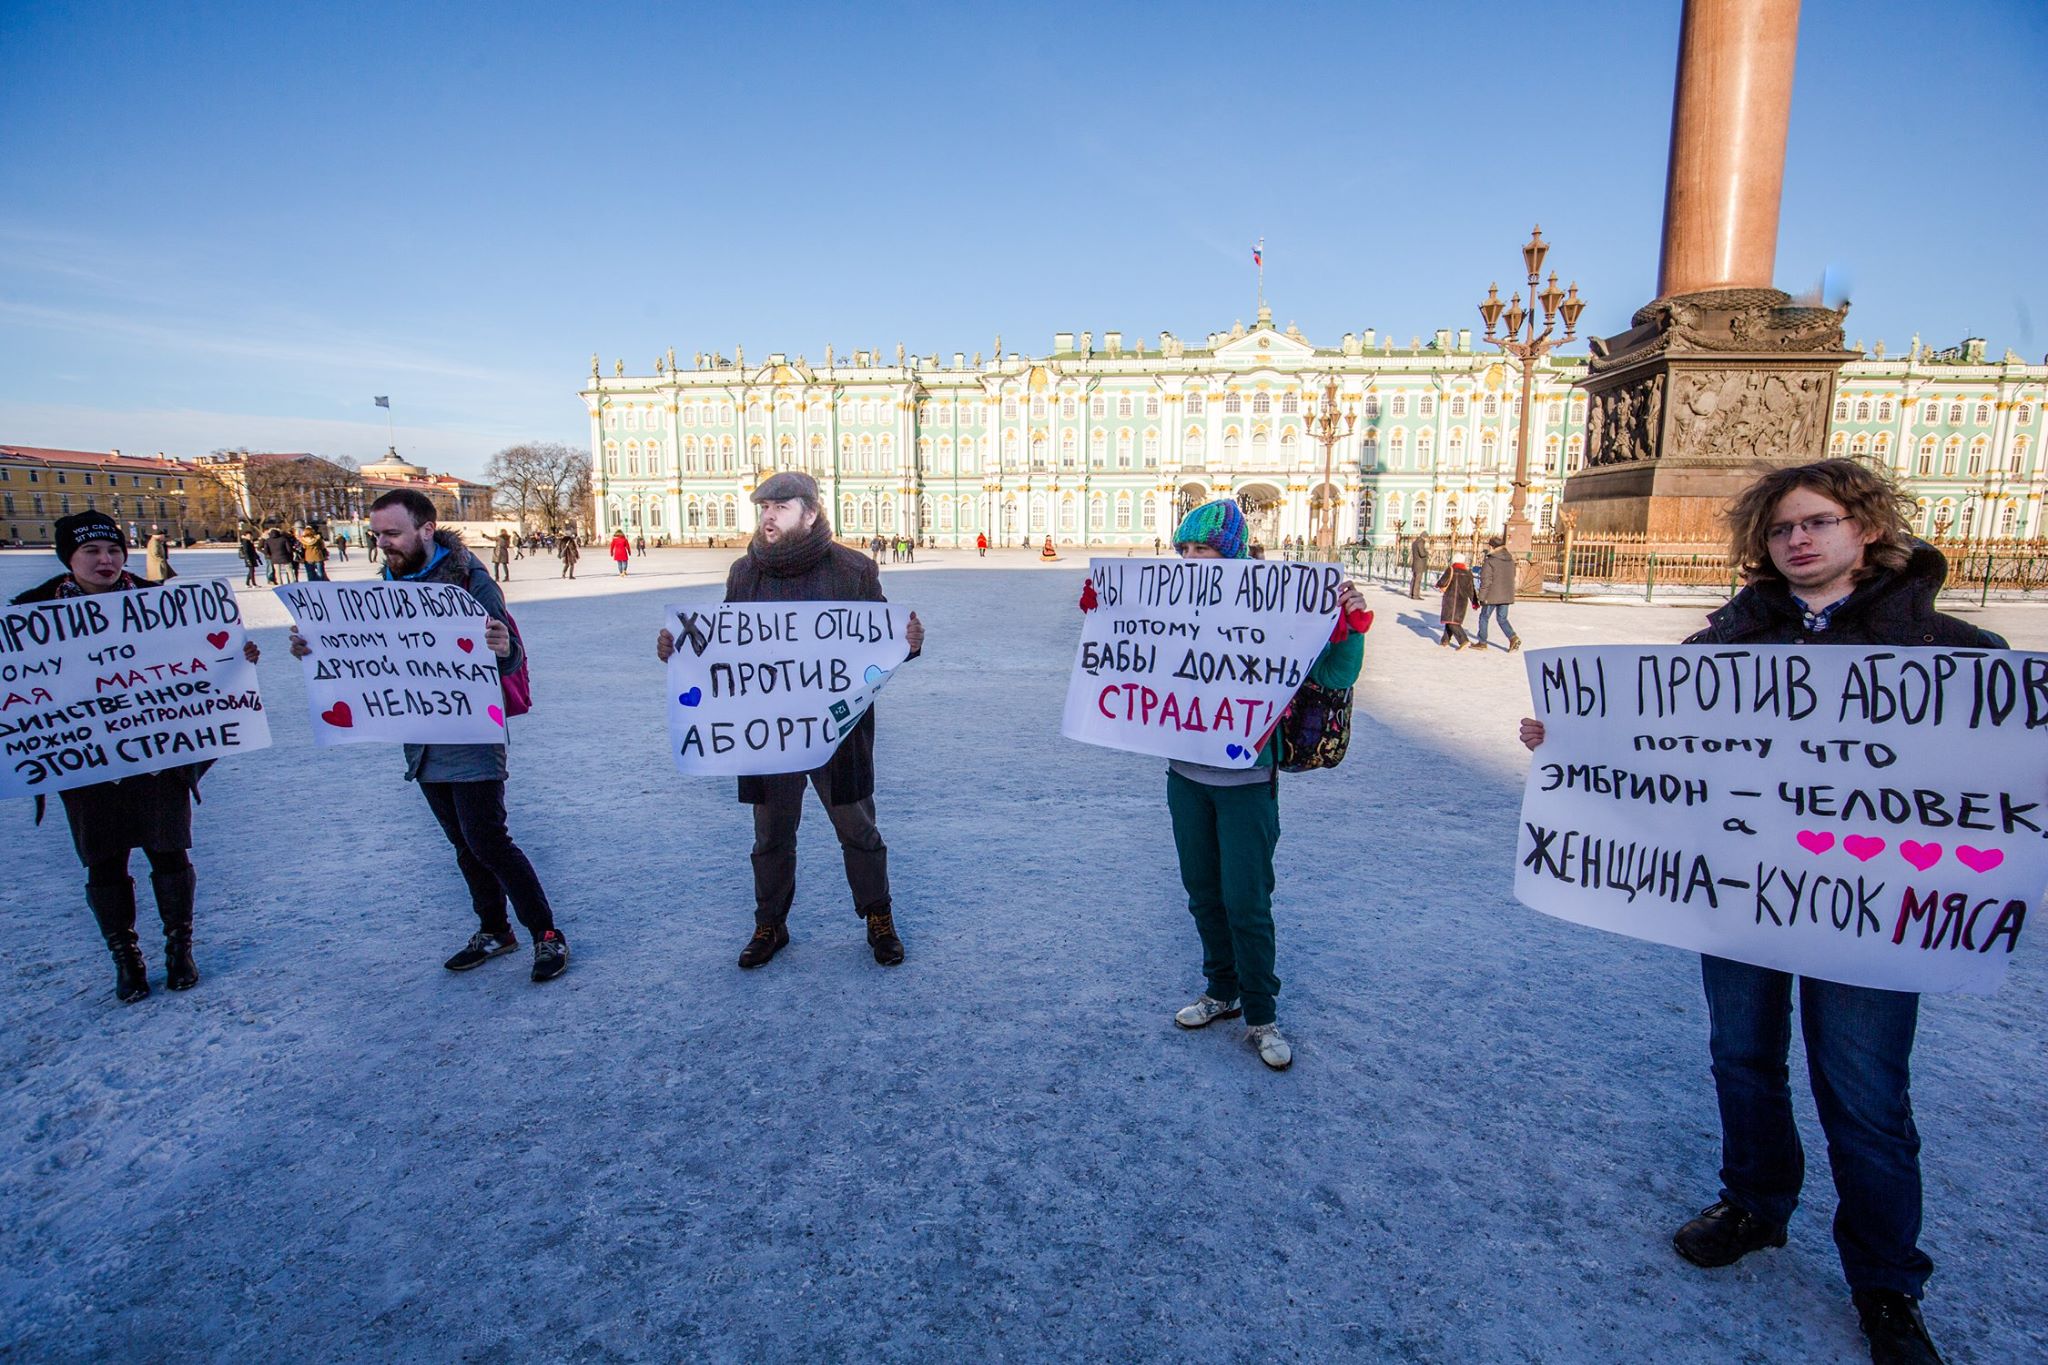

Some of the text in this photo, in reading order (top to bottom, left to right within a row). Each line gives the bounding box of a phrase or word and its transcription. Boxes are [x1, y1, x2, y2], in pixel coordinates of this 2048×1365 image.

[73, 526, 89, 534] YOU
[75, 531, 119, 543] SIT WITH US
[1092, 565, 1123, 608] МЫ
[1139, 563, 1223, 608] ПРОТИВ
[288, 587, 330, 623] МЫ
[338, 586, 417, 622] ПРОТИВ
[398, 631, 436, 649] ЧТО
[814, 608, 893, 643] ОТЦЫ
[1113, 619, 1265, 644] ПОТОМУ ЧТО
[88, 644, 136, 666] ЧТО
[313, 655, 498, 686] ДРУГОЙ ПЛАКАТ
[1081, 640, 1156, 675] БАБЫ
[0, 688, 53, 711] АЯ
[96, 658, 208, 693] МАТКА
[710, 658, 851, 698] ПРОТИВ
[1541, 657, 1606, 717] МЫ
[1638, 651, 1817, 721] ПРОТИВ
[362, 688, 472, 718] НЕЛЬЗЯ
[5, 691, 262, 756] МОЖНО КОНТРОЛИРОВАТЬ
[15, 722, 240, 784] ЭТОЙ СТРАНЕ
[1800, 739, 1897, 768] ЧТО
[1540, 763, 1709, 806] ЭМБРИОН
[1891, 886, 2027, 953] МЯСА
